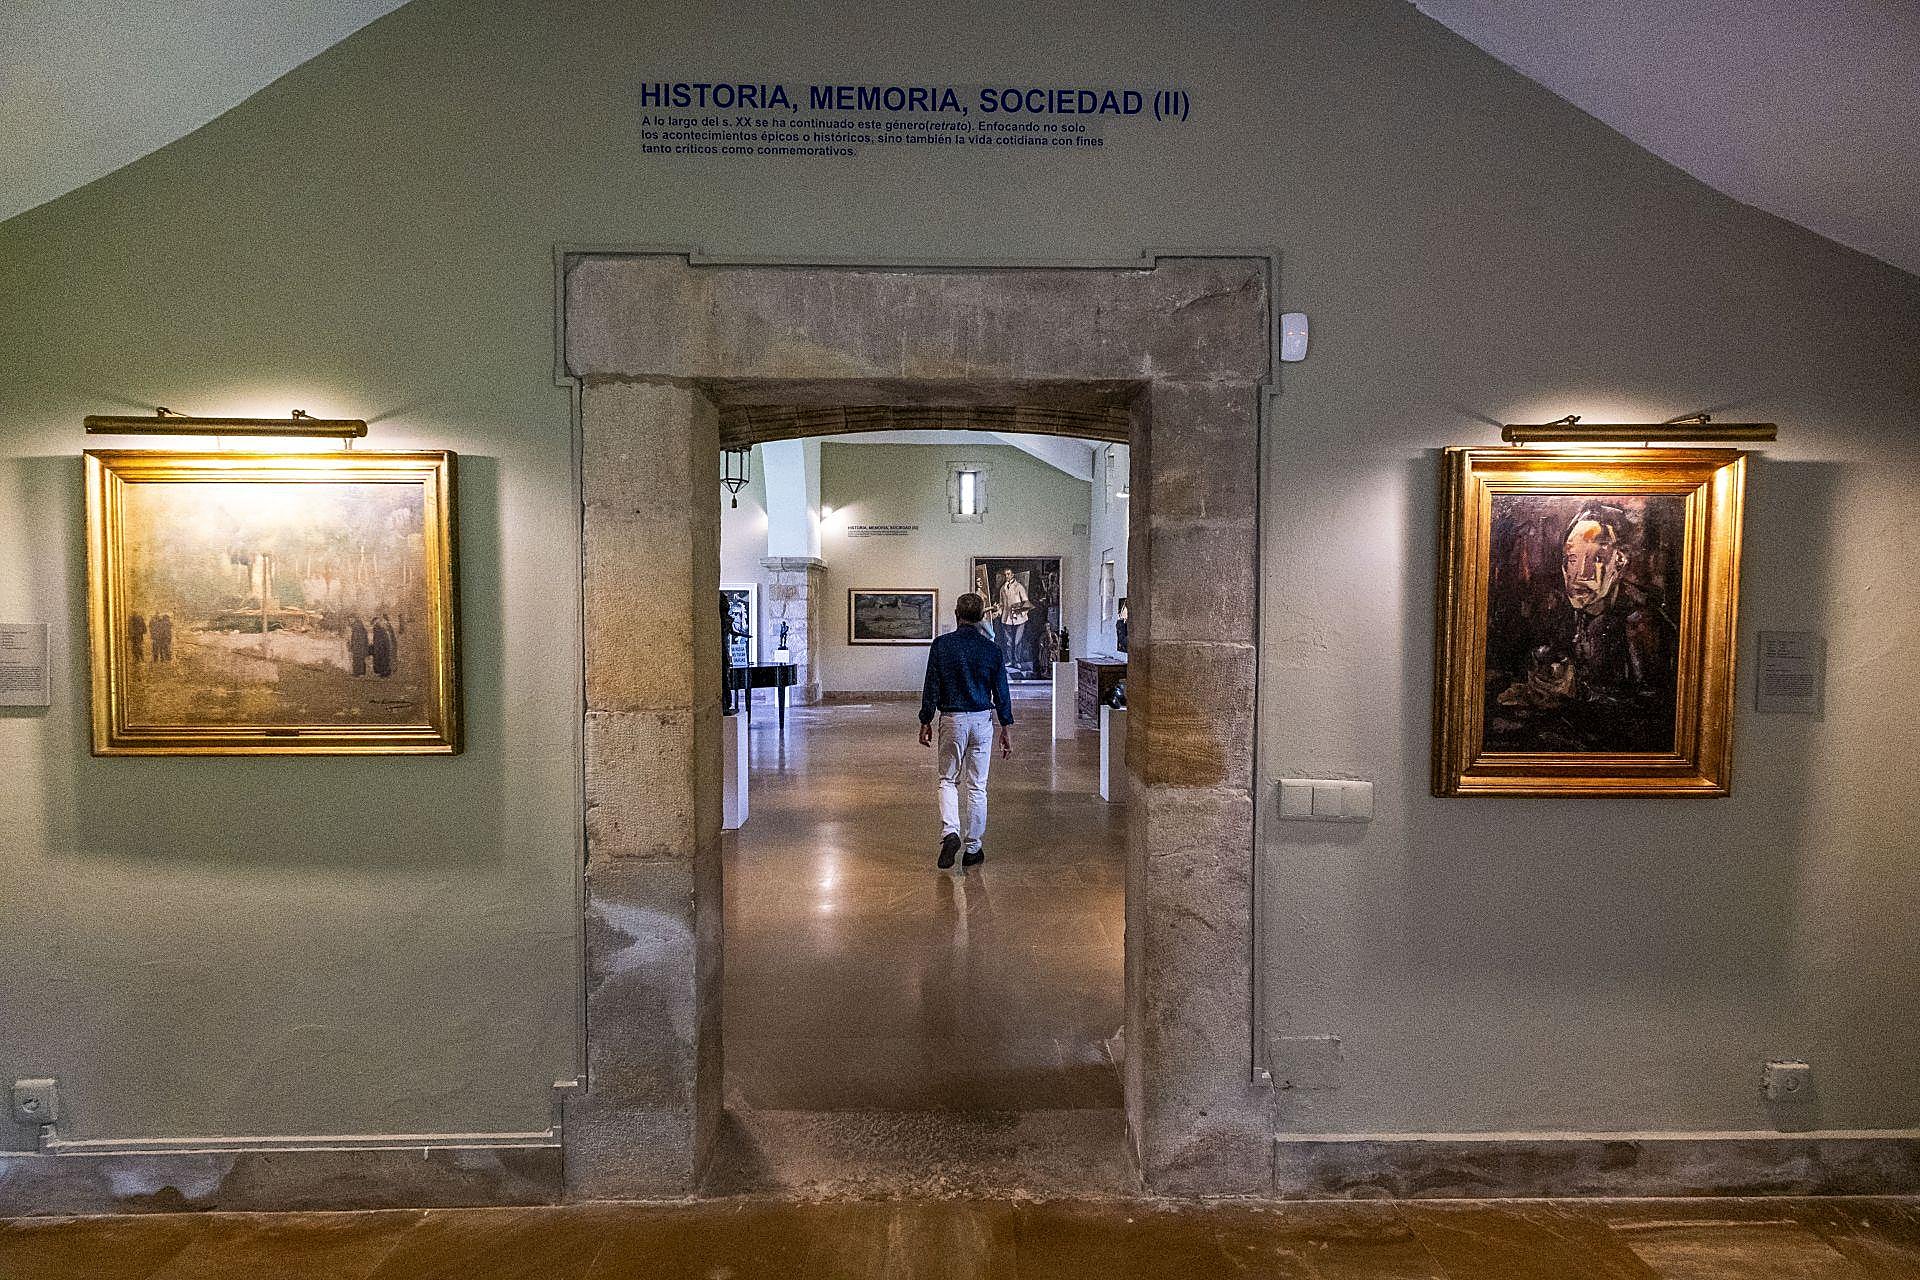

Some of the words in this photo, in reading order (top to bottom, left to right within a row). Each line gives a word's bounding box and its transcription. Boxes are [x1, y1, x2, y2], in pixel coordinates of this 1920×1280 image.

[641, 82, 798, 113] HISTORIA,
[810, 85, 968, 117] MEMORIA,
[979, 88, 1143, 115] SOCIEDAD
[1153, 90, 1190, 122] (II)
[641, 116, 651, 126] A
[653, 116, 665, 126] lo
[668, 116, 698, 129] largo
[701, 117, 719, 127] del
[722, 119, 733, 127] s.
[735, 117, 752, 127] XX
[755, 119, 769, 128] se
[772, 118, 786, 128] ha
[789, 118, 855, 130] continuado
[857, 120, 882, 130] este
[978, 121, 1040, 132] Enfocando
[1043, 123, 1058, 132] no
[1060, 122, 1086, 133] solo
[641, 129, 659, 140] los
[662, 130, 758, 142] acontecimientos
[761, 131, 799, 144] épicos
[802, 134, 811, 142] o
[813, 132, 874, 144] históricos,
[877, 133, 903, 144] sino
[905, 133, 951, 145] también
[955, 134, 965, 145] la
[968, 135, 993, 145] vida
[995, 135, 1048, 146] cotidiana
[1051, 137, 1073, 146] con
[1076, 136, 1104, 147] fines
[641, 143, 672, 154] tanto
[675, 143, 718, 155] críticos
[721, 146, 754, 155] como
[757, 145, 857, 157] conmemorativos.
